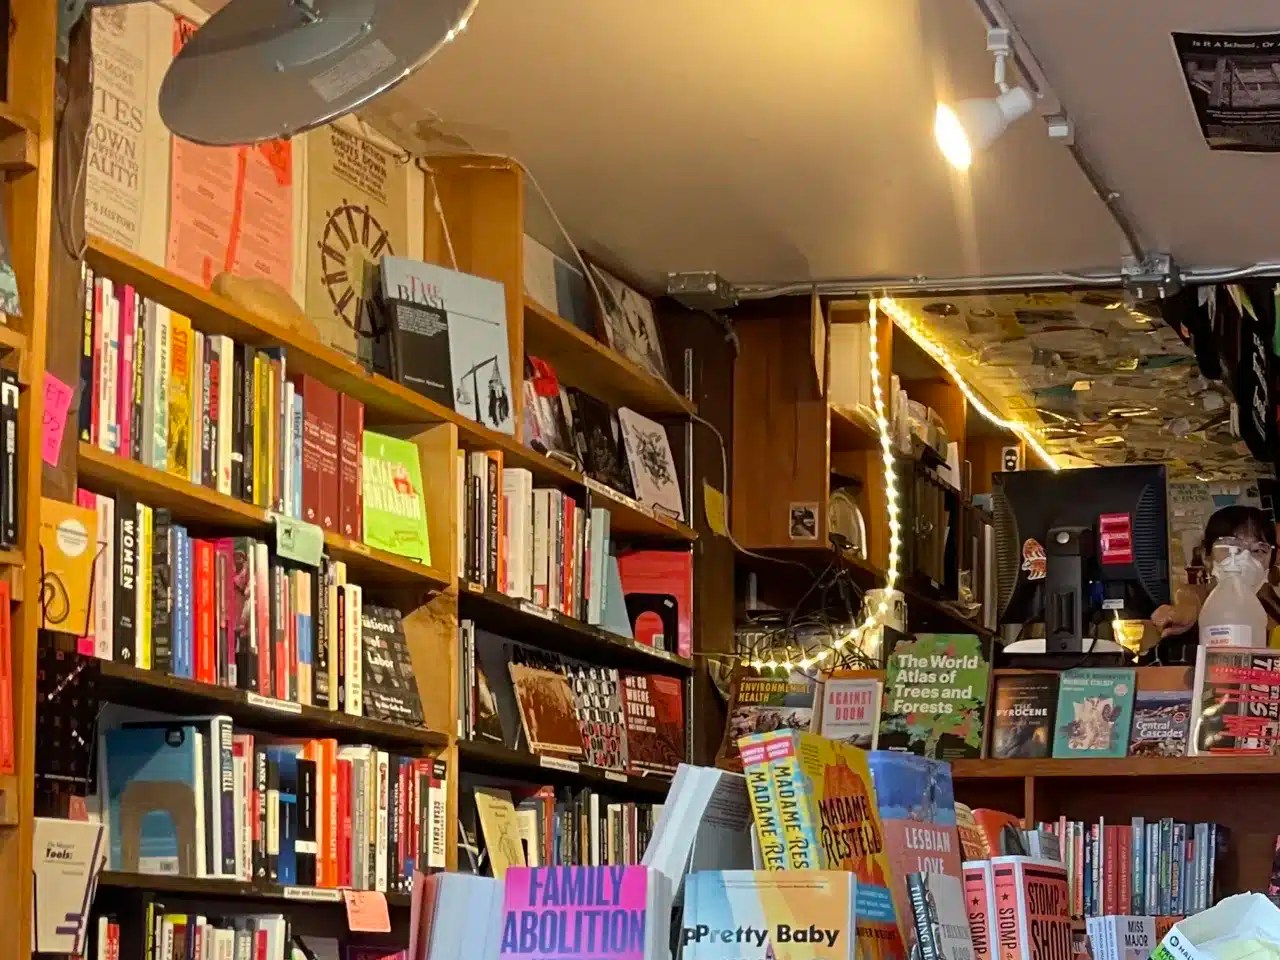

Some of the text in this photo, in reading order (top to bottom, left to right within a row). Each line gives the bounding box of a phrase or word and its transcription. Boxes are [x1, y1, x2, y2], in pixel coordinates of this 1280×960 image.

[123, 519, 134, 590] WOMEN
[898, 654, 979, 670] The World
[896, 669, 957, 684] Atlas of
[739, 693, 770, 703] HEALTH
[894, 684, 973, 700] Trees and
[835, 706, 865, 720] DOOM
[893, 699, 954, 715] Forests
[996, 708, 1049, 719] PYROCENE
[1136, 720, 1171, 731] Central
[1140, 727, 1184, 738] Cascades
[749, 771, 772, 837] MADAME
[774, 765, 799, 834] MADAME
[819, 795, 870, 829] MADAME
[904, 826, 952, 853] LESBIAN
[528, 866, 626, 907] FAMILY
[1028, 881, 1059, 917] STOMP
[910, 884, 930, 944] THINNING
[1127, 920, 1144, 933] MISS
[500, 909, 646, 956] ABOLITION
[695, 922, 840, 949] Pretty Baby
[969, 912, 987, 954] STOMP
[999, 907, 1017, 949] STOMP
[1124, 934, 1149, 947] MAJOR
